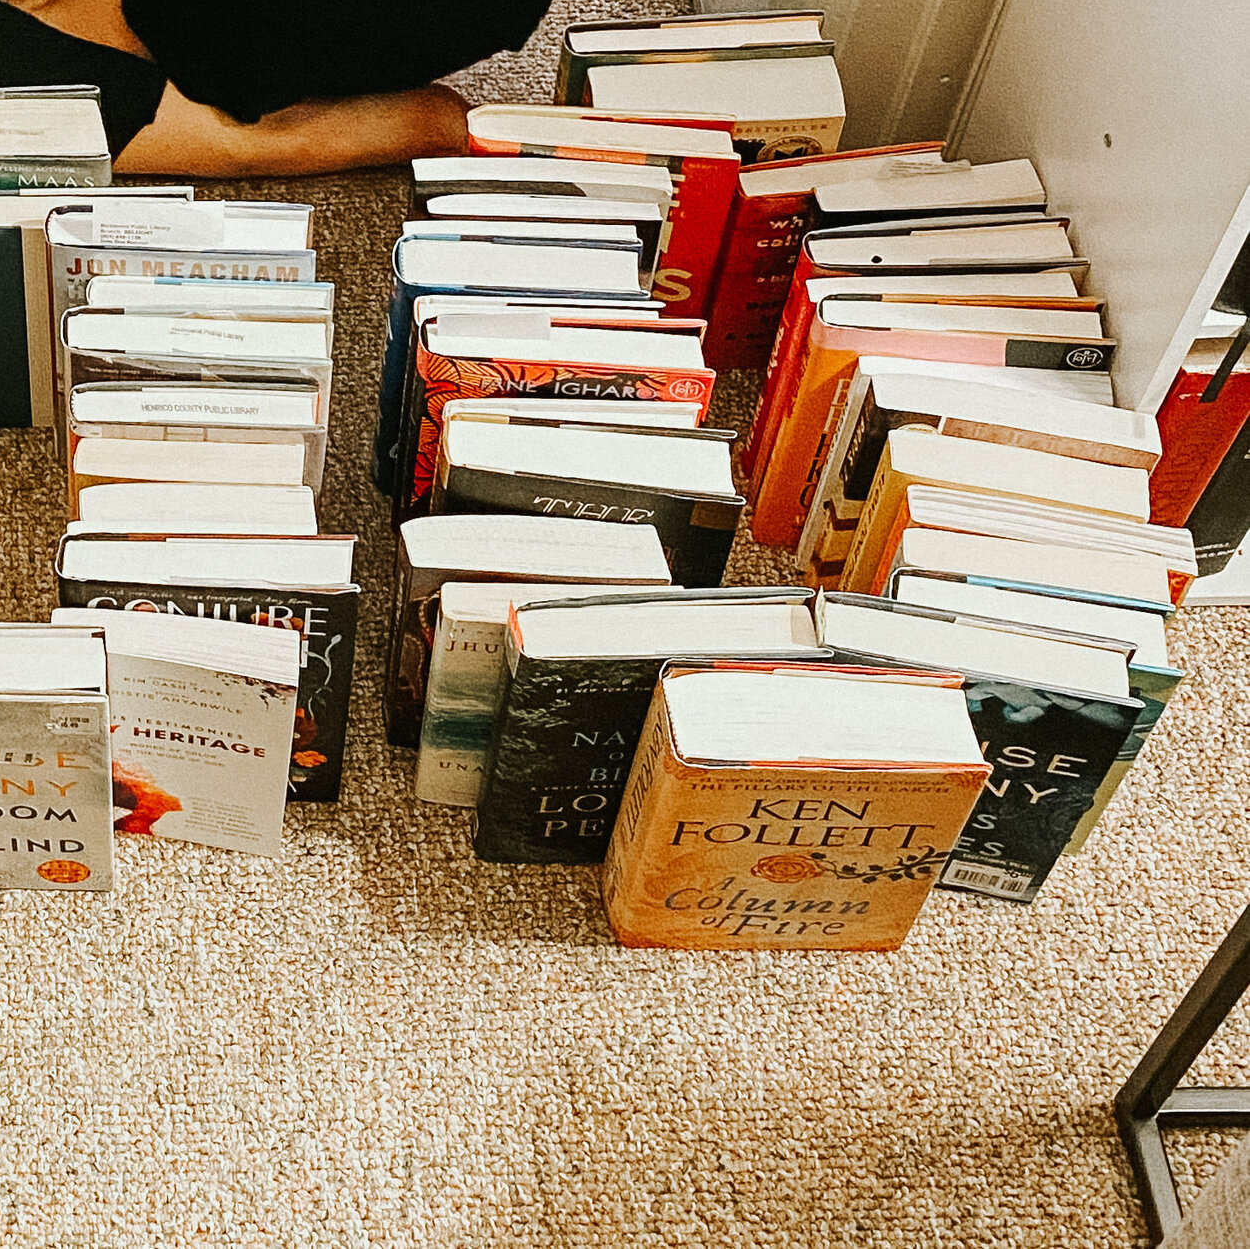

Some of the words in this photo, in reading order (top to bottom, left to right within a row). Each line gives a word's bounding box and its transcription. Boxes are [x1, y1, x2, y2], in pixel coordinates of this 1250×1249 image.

[18, 174, 95, 188] MAAS
[65, 257, 127, 276] JON
[141, 259, 300, 283] MEACHAM
[553, 381, 658, 399] IGHARO
[141, 404, 174, 412] HENRICO
[174, 404, 203, 413] COUNTY
[203, 405, 231, 414] PUBLIC
[230, 407, 260, 415] LIBRARY
[123, 676, 146, 684] KIM
[152, 680, 187, 690] CASH
[110, 690, 155, 700] RISTIE
[162, 696, 243, 715] ANYABWILE
[137, 717, 244, 740] TESTIMONIES
[133, 726, 266, 758] HERITAGE
[689, 783, 723, 791] THE
[733, 783, 806, 792] PILLARS
[811, 784, 835, 792] OF
[846, 784, 880, 793] THE
[746, 798, 872, 822] KEN
[669, 820, 936, 850] FOLLETT
[709, 877, 735, 892] A
[664, 887, 871, 916] Column
[701, 912, 732, 937] of
[727, 913, 846, 937] Fire
